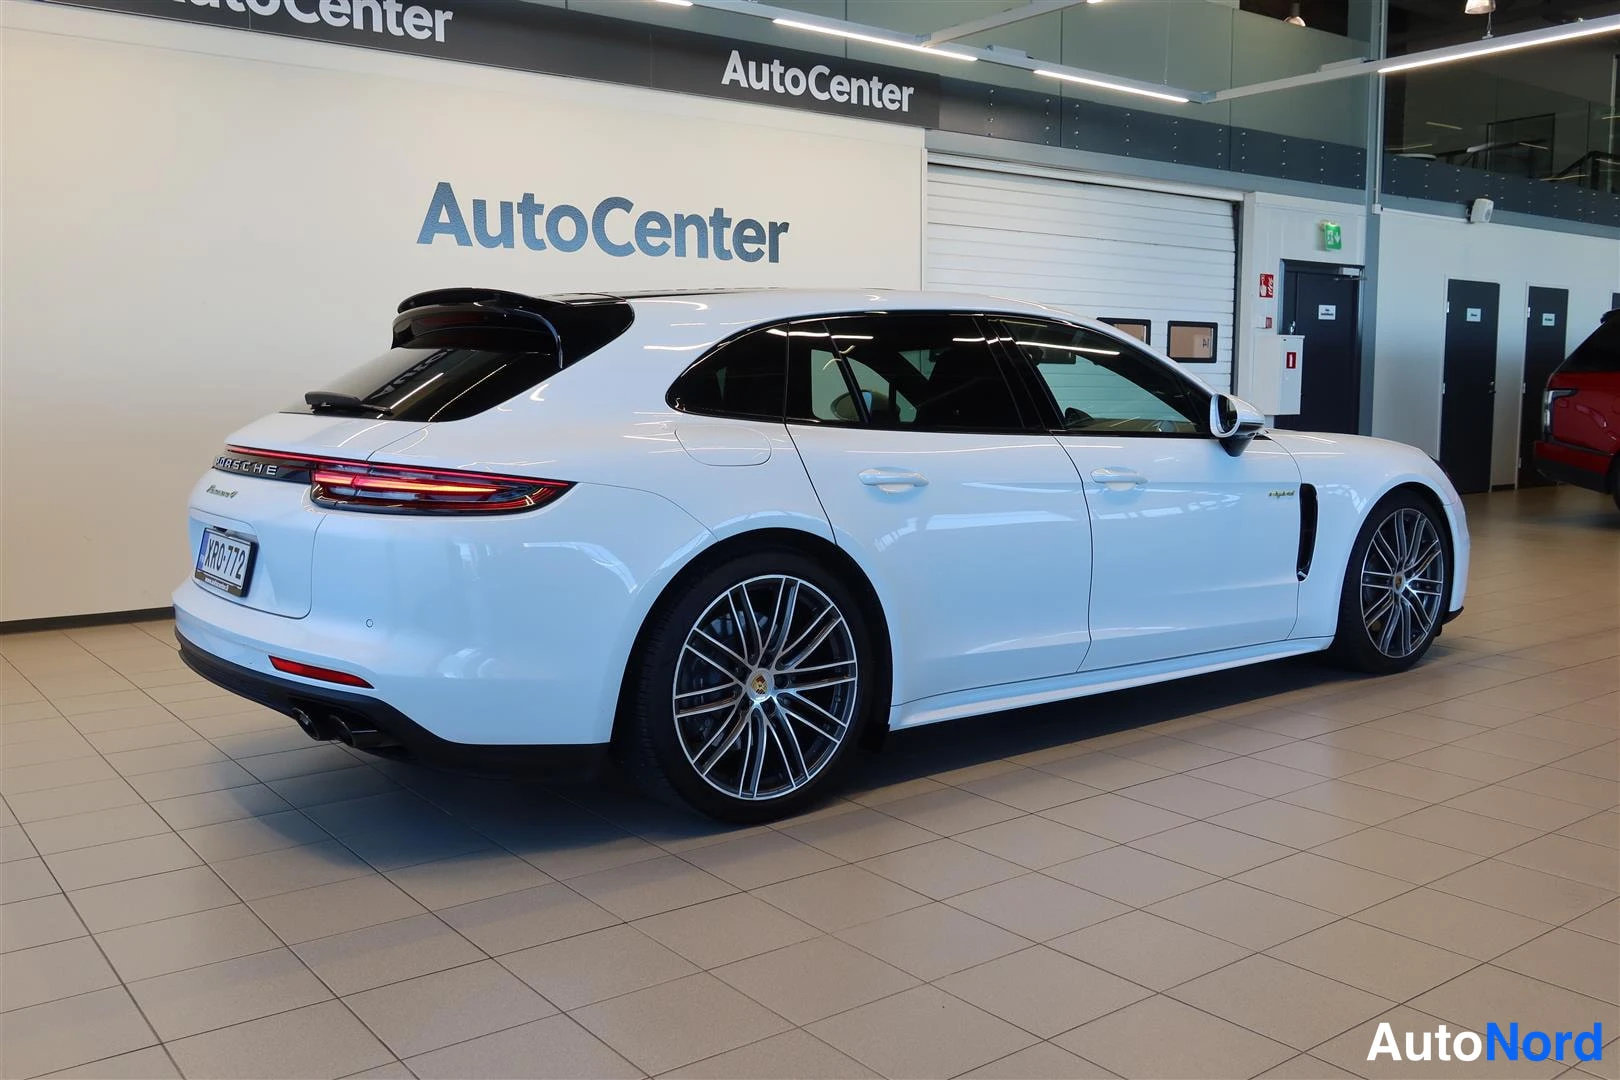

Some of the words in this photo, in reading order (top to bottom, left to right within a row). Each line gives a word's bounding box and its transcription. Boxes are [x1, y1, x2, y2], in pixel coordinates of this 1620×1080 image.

[171, 0, 453, 43] Center
[721, 50, 915, 112] AutoCenter
[416, 181, 790, 264] AutoCenter
[215, 457, 277, 475] PORSCHE
[204, 538, 246, 580] XRO-772
